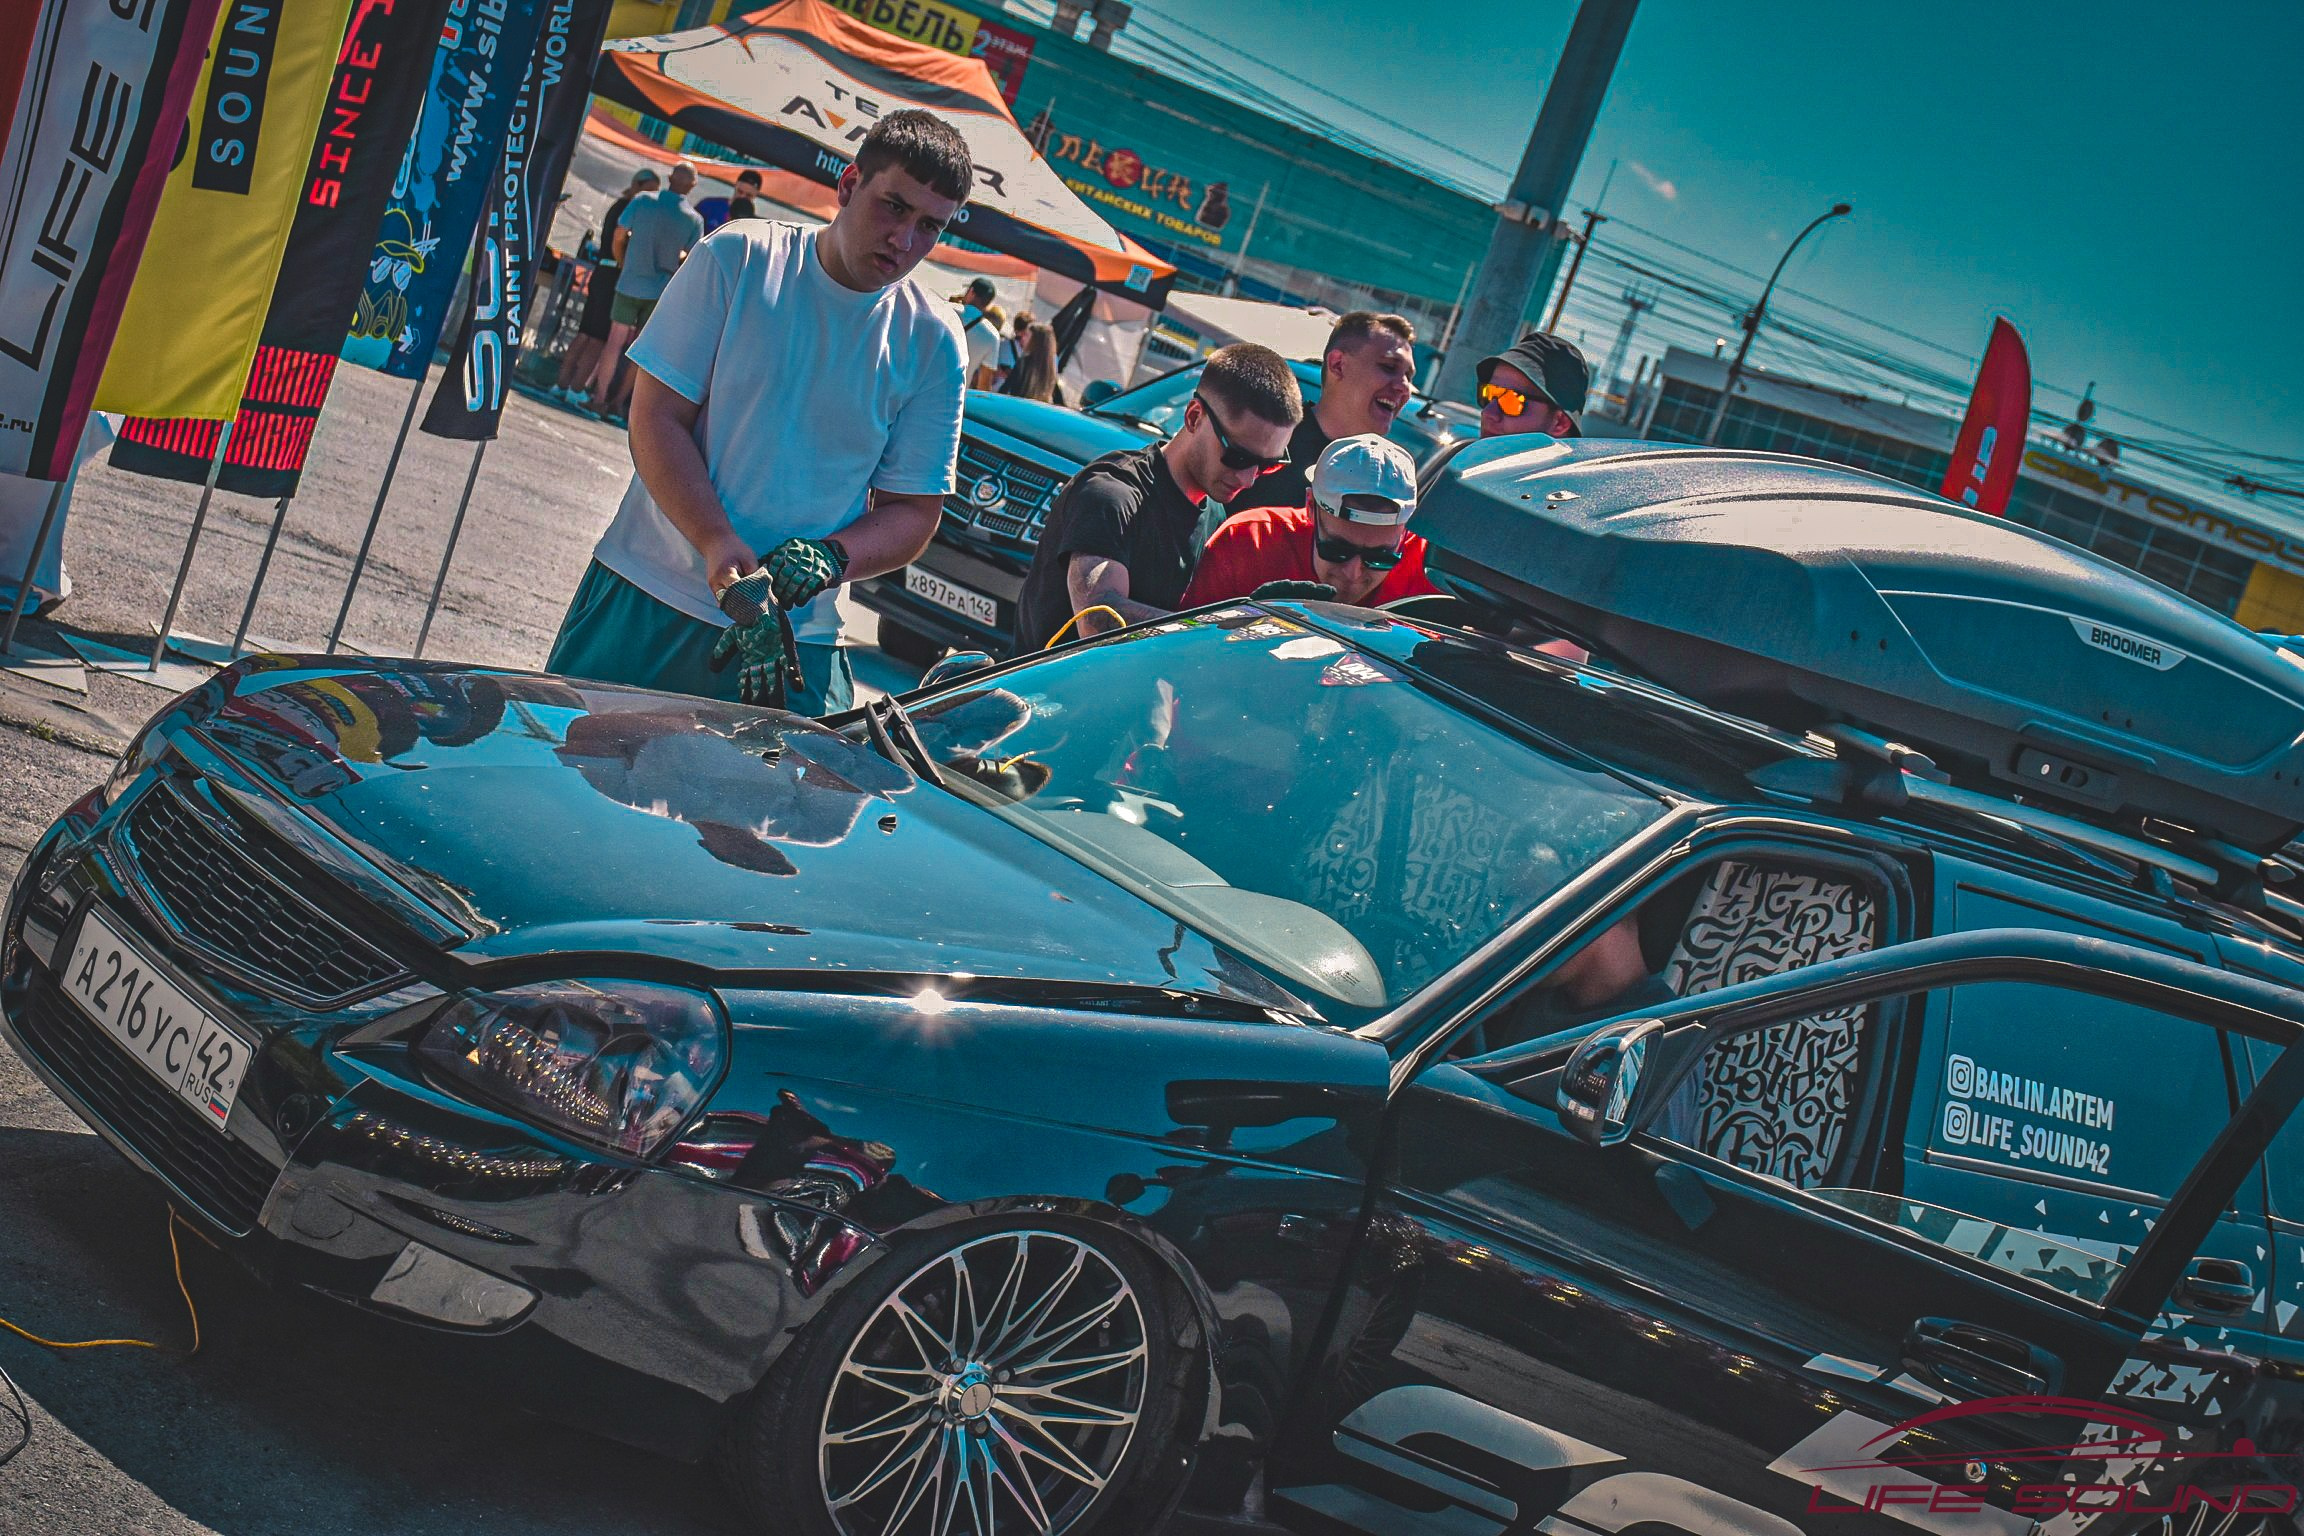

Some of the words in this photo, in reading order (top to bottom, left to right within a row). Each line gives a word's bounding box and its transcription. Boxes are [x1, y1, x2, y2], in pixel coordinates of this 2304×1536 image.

[829, 0, 965, 51] БЕЛЬ
[309, 40, 382, 208] SINCE
[1156, 212, 1222, 247] ТОВАРОВ
[506, 247, 521, 346] PAINT
[2091, 627, 2161, 665] BROOMER
[186, 1073, 213, 1105] RUS
[196, 1030, 233, 1092] 42
[1976, 1066, 2114, 1131] BARLIN.ARTEM
[1970, 1111, 2111, 1175] LIFE_SOUND42
